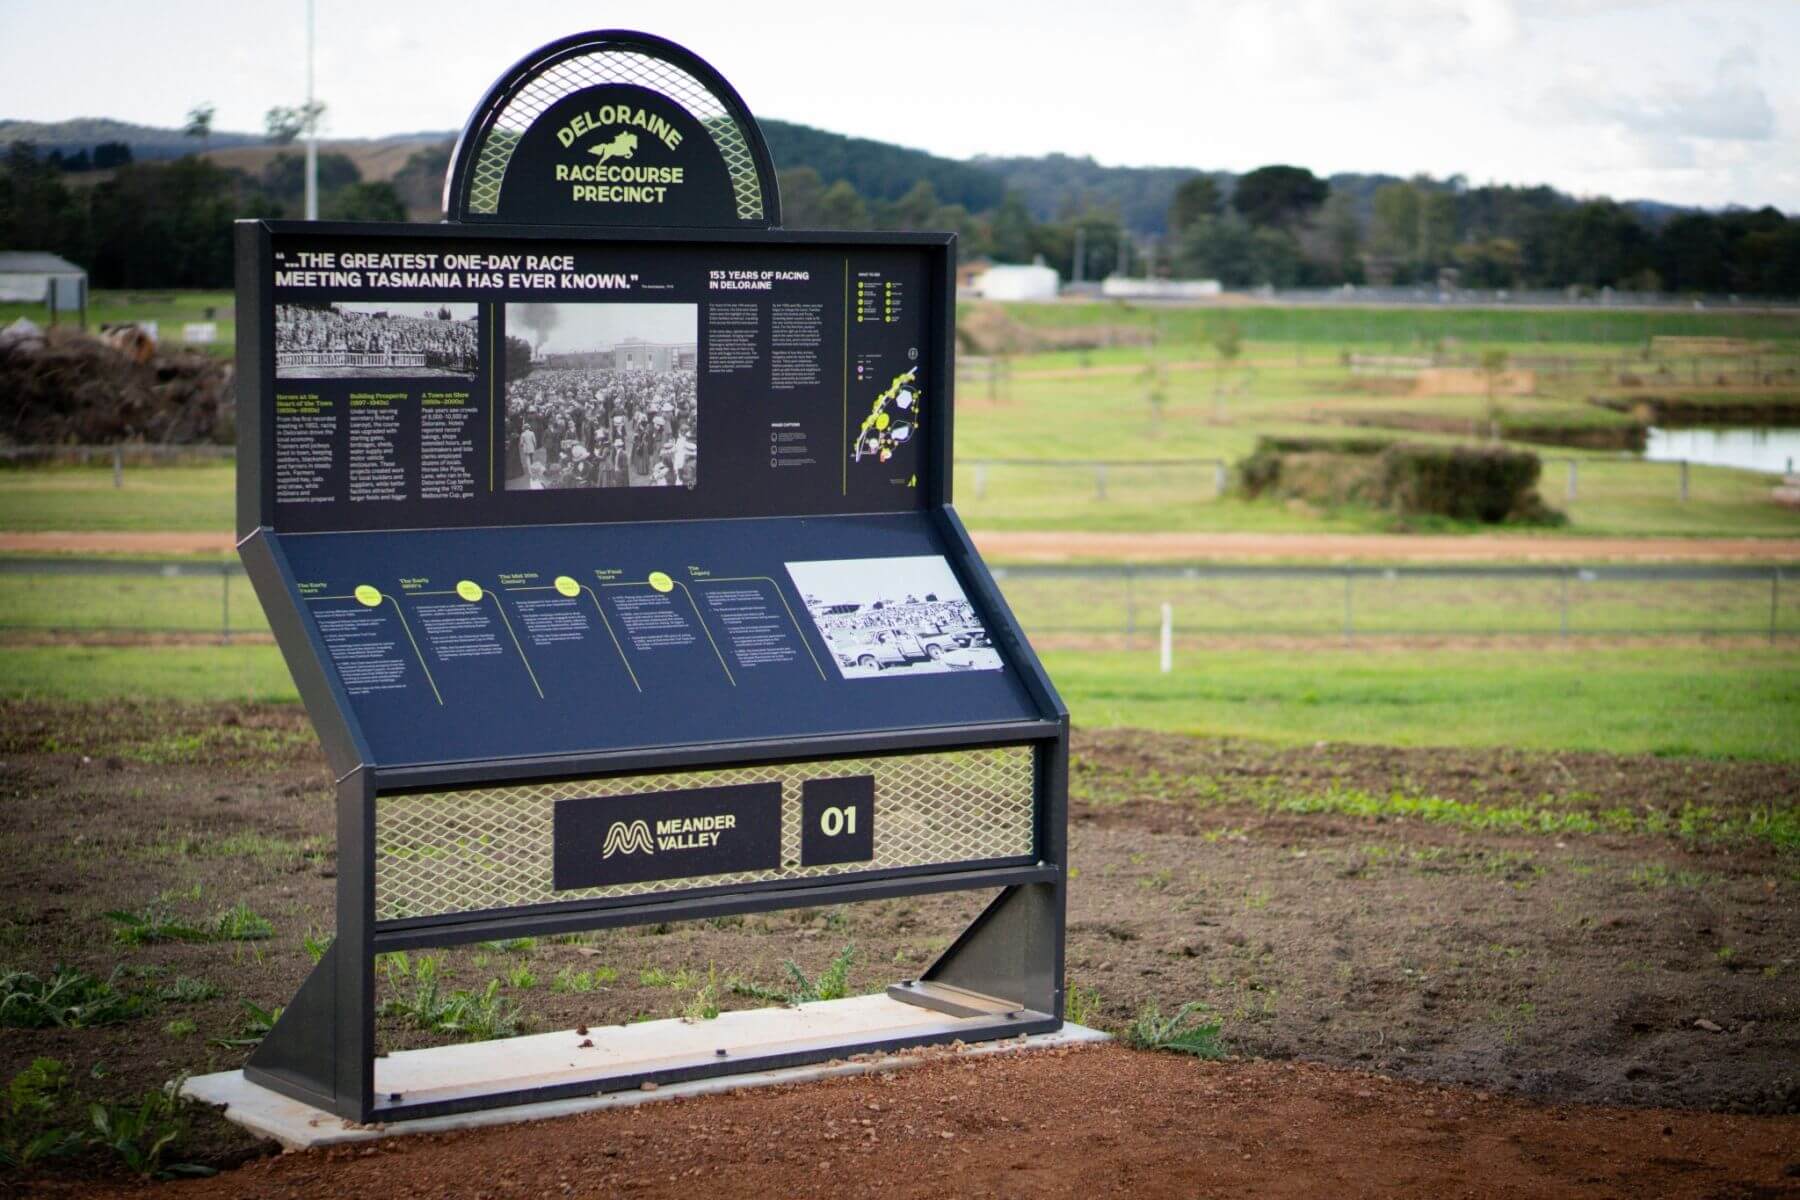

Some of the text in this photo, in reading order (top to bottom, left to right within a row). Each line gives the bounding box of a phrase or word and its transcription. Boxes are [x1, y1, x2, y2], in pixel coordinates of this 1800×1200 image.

[556, 104, 684, 151] DELORAINE
[555, 164, 684, 184] RACECOURSE
[572, 185, 667, 203] PRECINCT
[340, 253, 438, 270] GREATEST
[443, 254, 523, 271] ONE-DAY
[526, 255, 575, 271] RACE
[275, 271, 362, 288] MEETING
[366, 272, 461, 288] TASMANIA
[467, 272, 504, 288] HAS
[508, 273, 556, 289] EVER
[709, 270, 810, 281] 153 YEARS OF RACING
[709, 281, 772, 290] IN DELORAINE
[656, 814, 737, 836] MEANDER
[820, 805, 857, 837] 01
[657, 832, 721, 851] VALLEY
